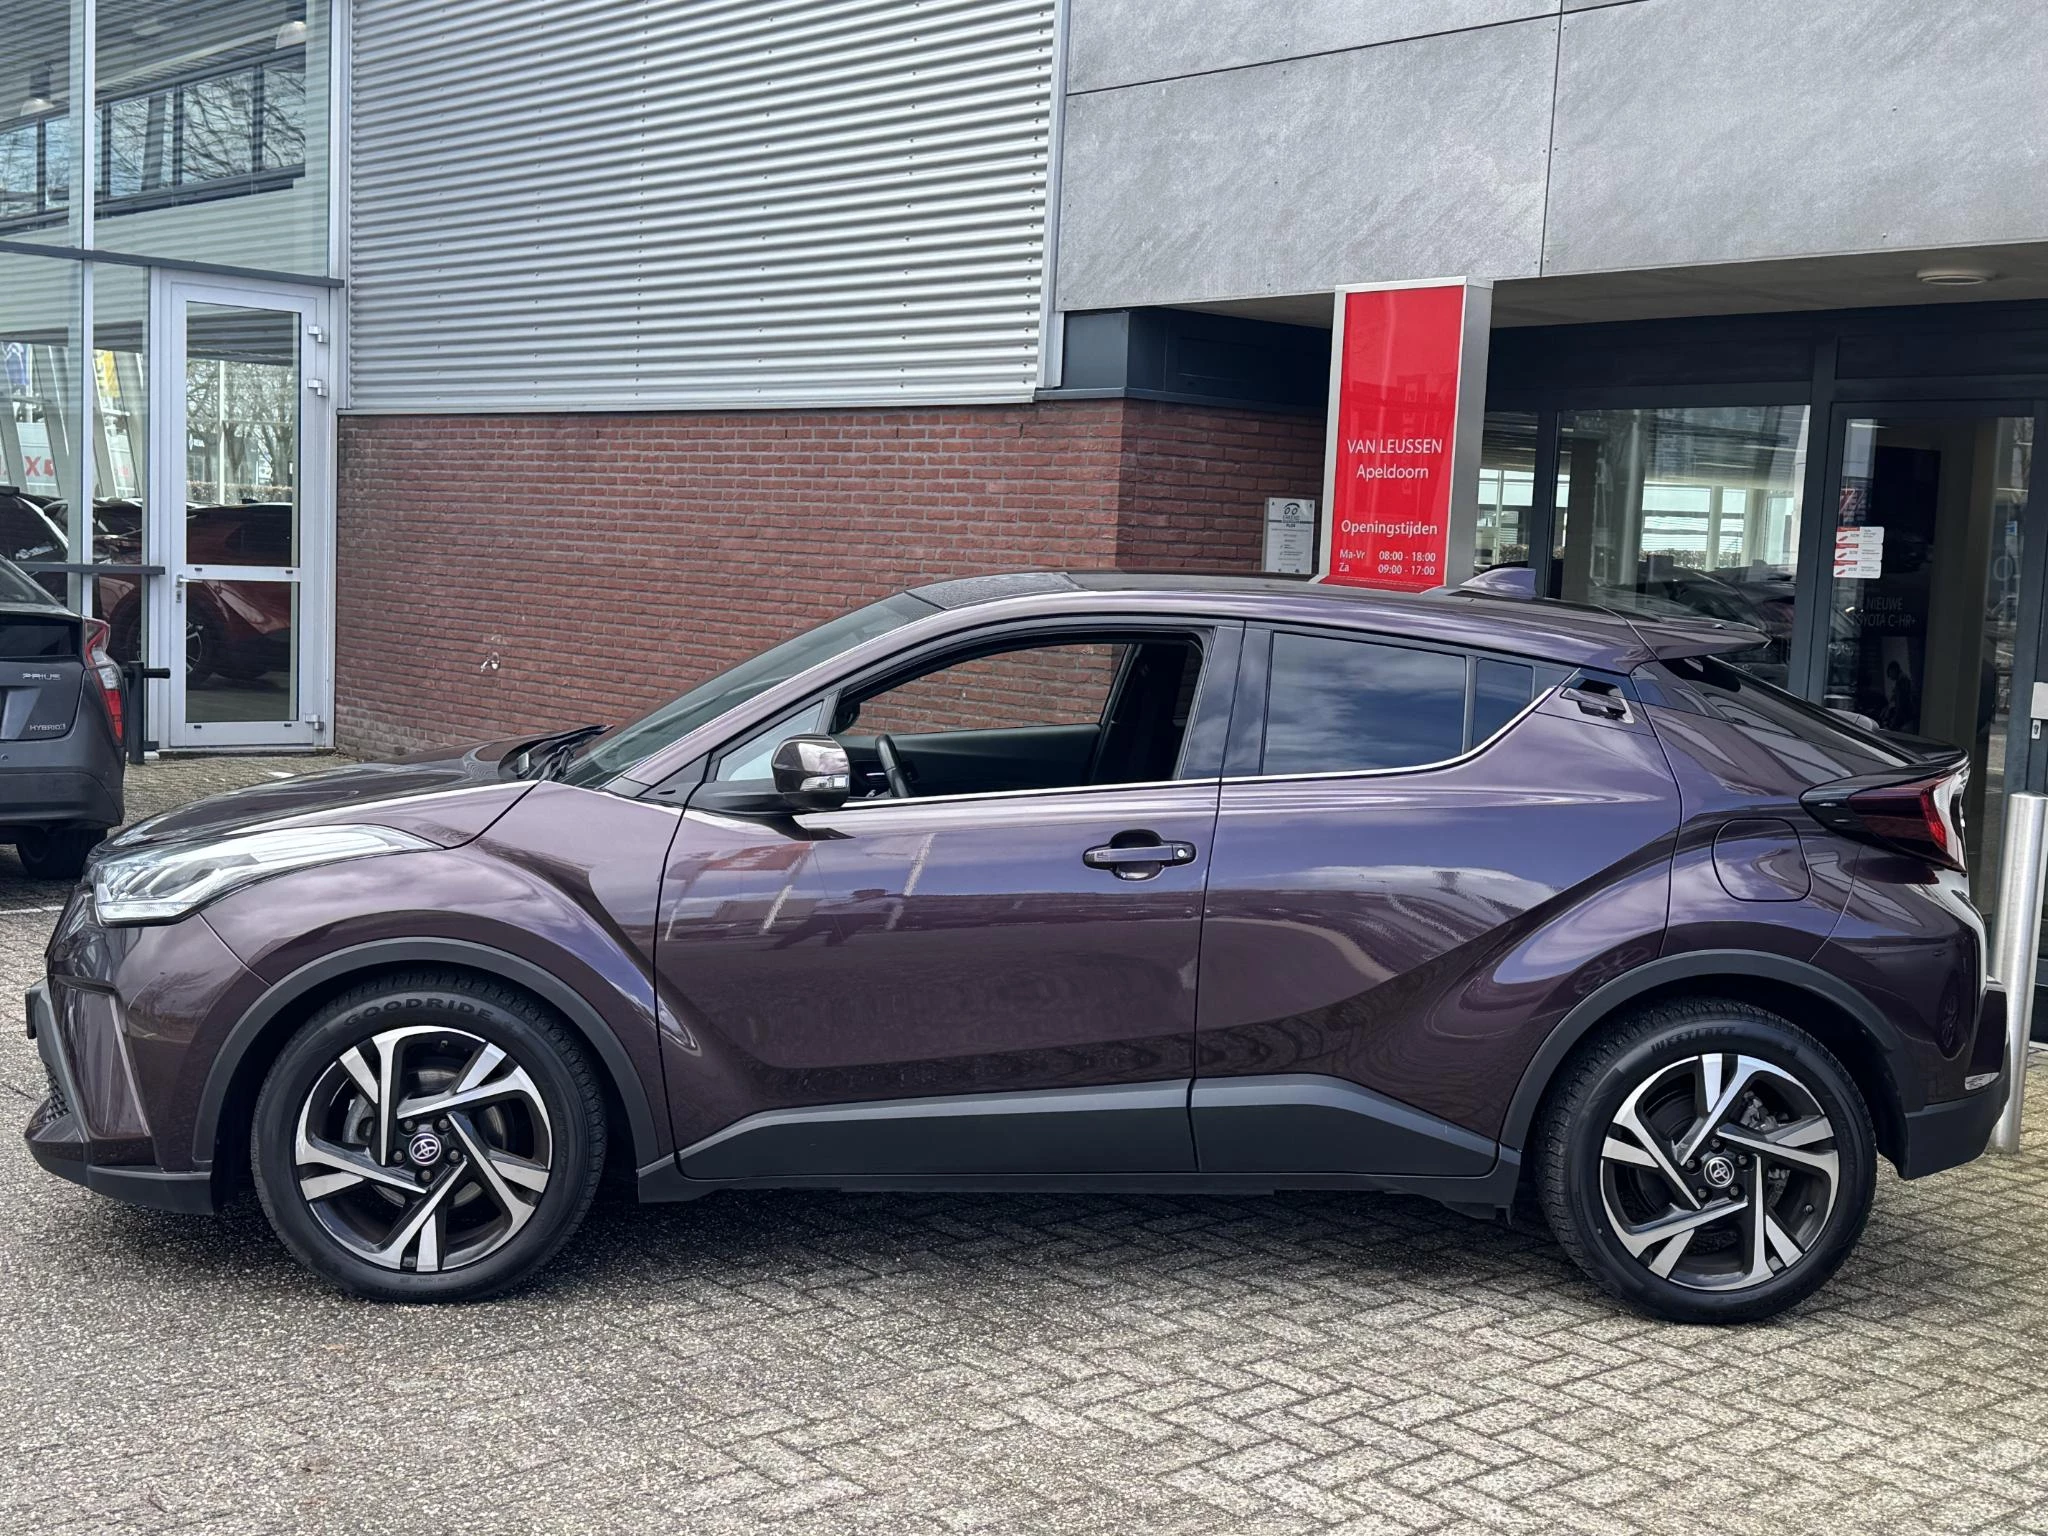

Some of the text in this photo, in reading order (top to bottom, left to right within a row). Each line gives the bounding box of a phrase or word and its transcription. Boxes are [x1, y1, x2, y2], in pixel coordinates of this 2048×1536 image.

[1347, 438, 1443, 454] VAN LEUSSEN
[1356, 463, 1429, 482] Apeldoorn
[1341, 519, 1438, 538] Openingstijden
[1339, 549, 1366, 559] Ma-Vr
[1379, 550, 1403, 561] 08:00
[1411, 551, 1436, 562] 18:00
[1338, 562, 1350, 572] Za
[1378, 564, 1402, 574] 09:00
[1411, 565, 1436, 576] 17:00
[1865, 596, 1904, 610] NIEUWE
[1854, 612, 1884, 627] OYOTA
[22, 672, 61, 681] PRIUS
[29, 724, 61, 732] HYBRID
[344, 998, 494, 1026] GOODRIDE
